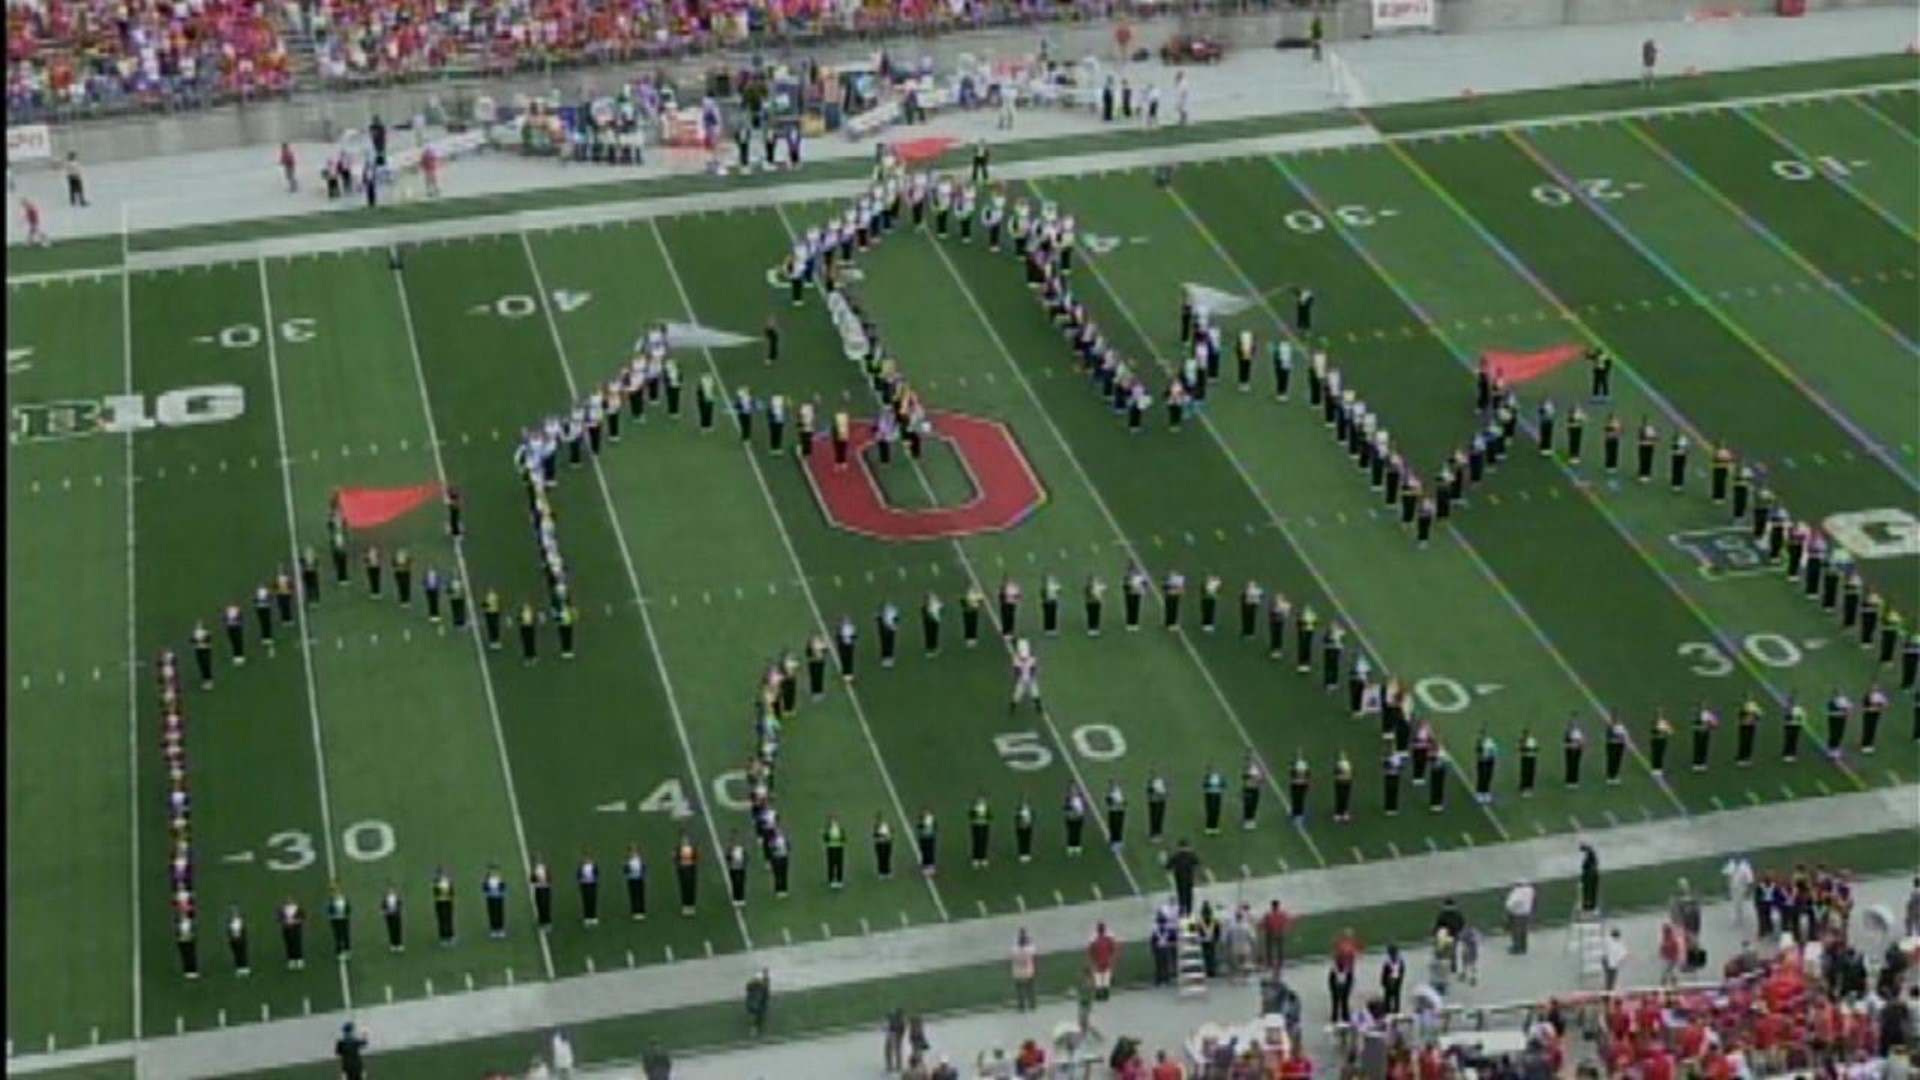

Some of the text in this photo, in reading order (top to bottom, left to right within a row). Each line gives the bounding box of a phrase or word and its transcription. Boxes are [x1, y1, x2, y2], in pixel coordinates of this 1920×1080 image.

[1531, 177, 1622, 207] 20
[1283, 204, 1378, 235] 30
[497, 289, 594, 317] 40
[219, 317, 318, 349] 30
[1677, 633, 1801, 678] 30
[1414, 676, 1472, 713] 0
[992, 723, 1127, 771] 50
[265, 819, 397, 872] 30
